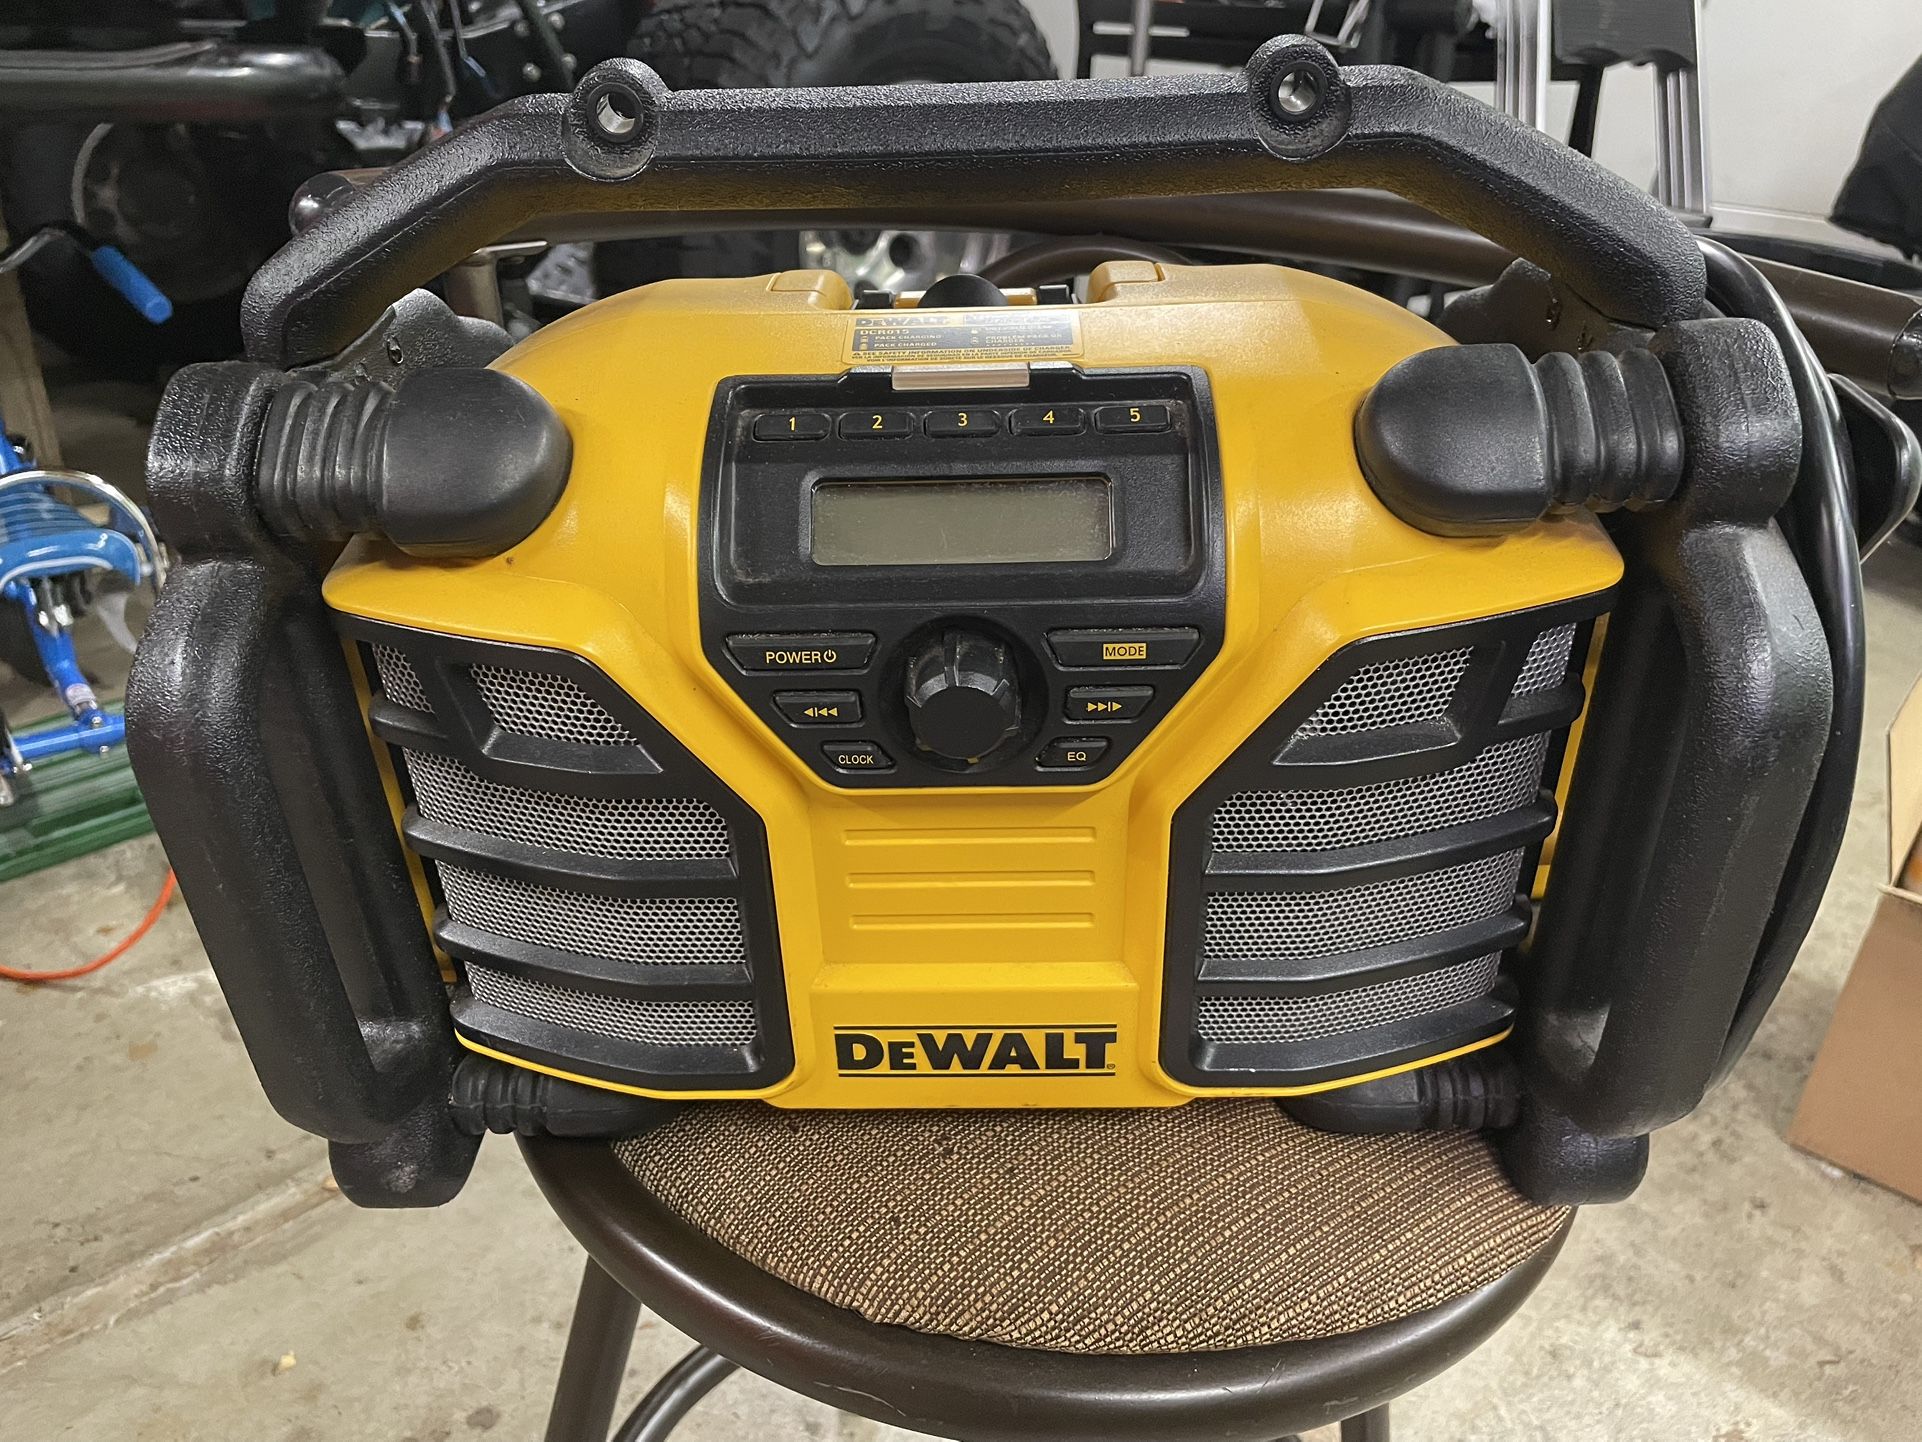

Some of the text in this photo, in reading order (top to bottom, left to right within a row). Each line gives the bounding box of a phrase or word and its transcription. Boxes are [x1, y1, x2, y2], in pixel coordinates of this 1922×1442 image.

[872, 415, 883, 429] 2
[958, 412, 968, 426] 3
[1042, 410, 1055, 424] 4
[1130, 408, 1141, 422] 5
[789, 416, 796, 431] 1
[766, 651, 822, 664] POWER
[1104, 645, 1145, 657] MODE
[838, 754, 874, 764] CLOCK
[1067, 752, 1087, 762] EQ
[834, 1032, 1117, 1070] DEWALT
